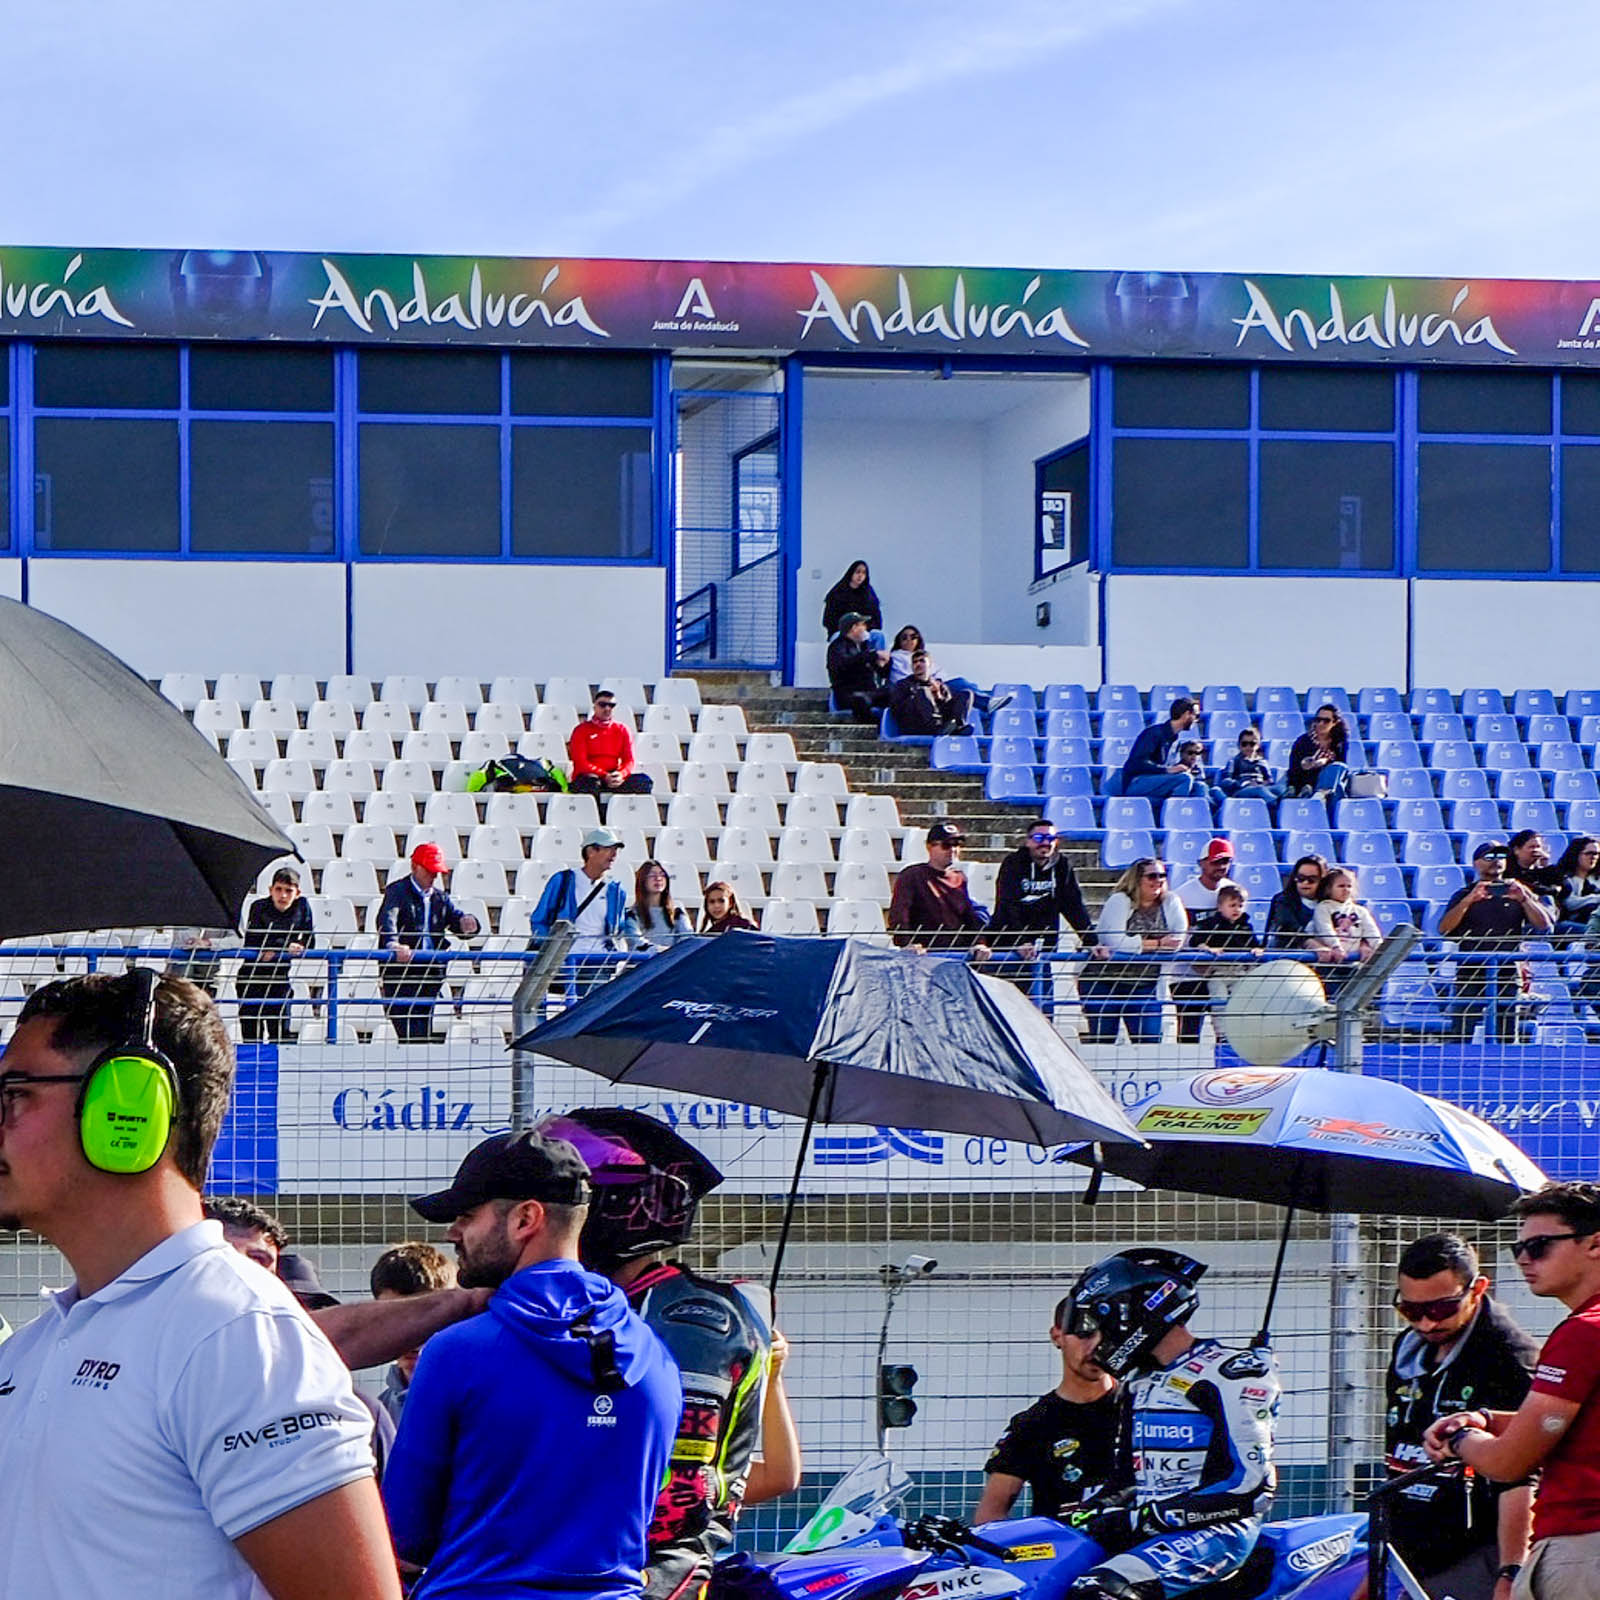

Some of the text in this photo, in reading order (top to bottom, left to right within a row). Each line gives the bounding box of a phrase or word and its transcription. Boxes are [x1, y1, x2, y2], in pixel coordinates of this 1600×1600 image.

[307, 258, 611, 337] Andalucía
[797, 270, 1090, 348] Andalucía
[652, 320, 679, 332] Junta
[680, 321, 692, 331] de
[1232, 280, 1518, 355] Andalucía
[332, 1086, 475, 1133] Cádiz
[1153, 1120, 1251, 1131] RACING
[964, 1136, 1006, 1165] de
[79, 1357, 122, 1382] DYRO
[223, 1411, 344, 1453] SAVE BODY
[1145, 1456, 1190, 1471] NKC
[1187, 1508, 1240, 1524] Blumaq
[941, 1573, 983, 1593] NKC
